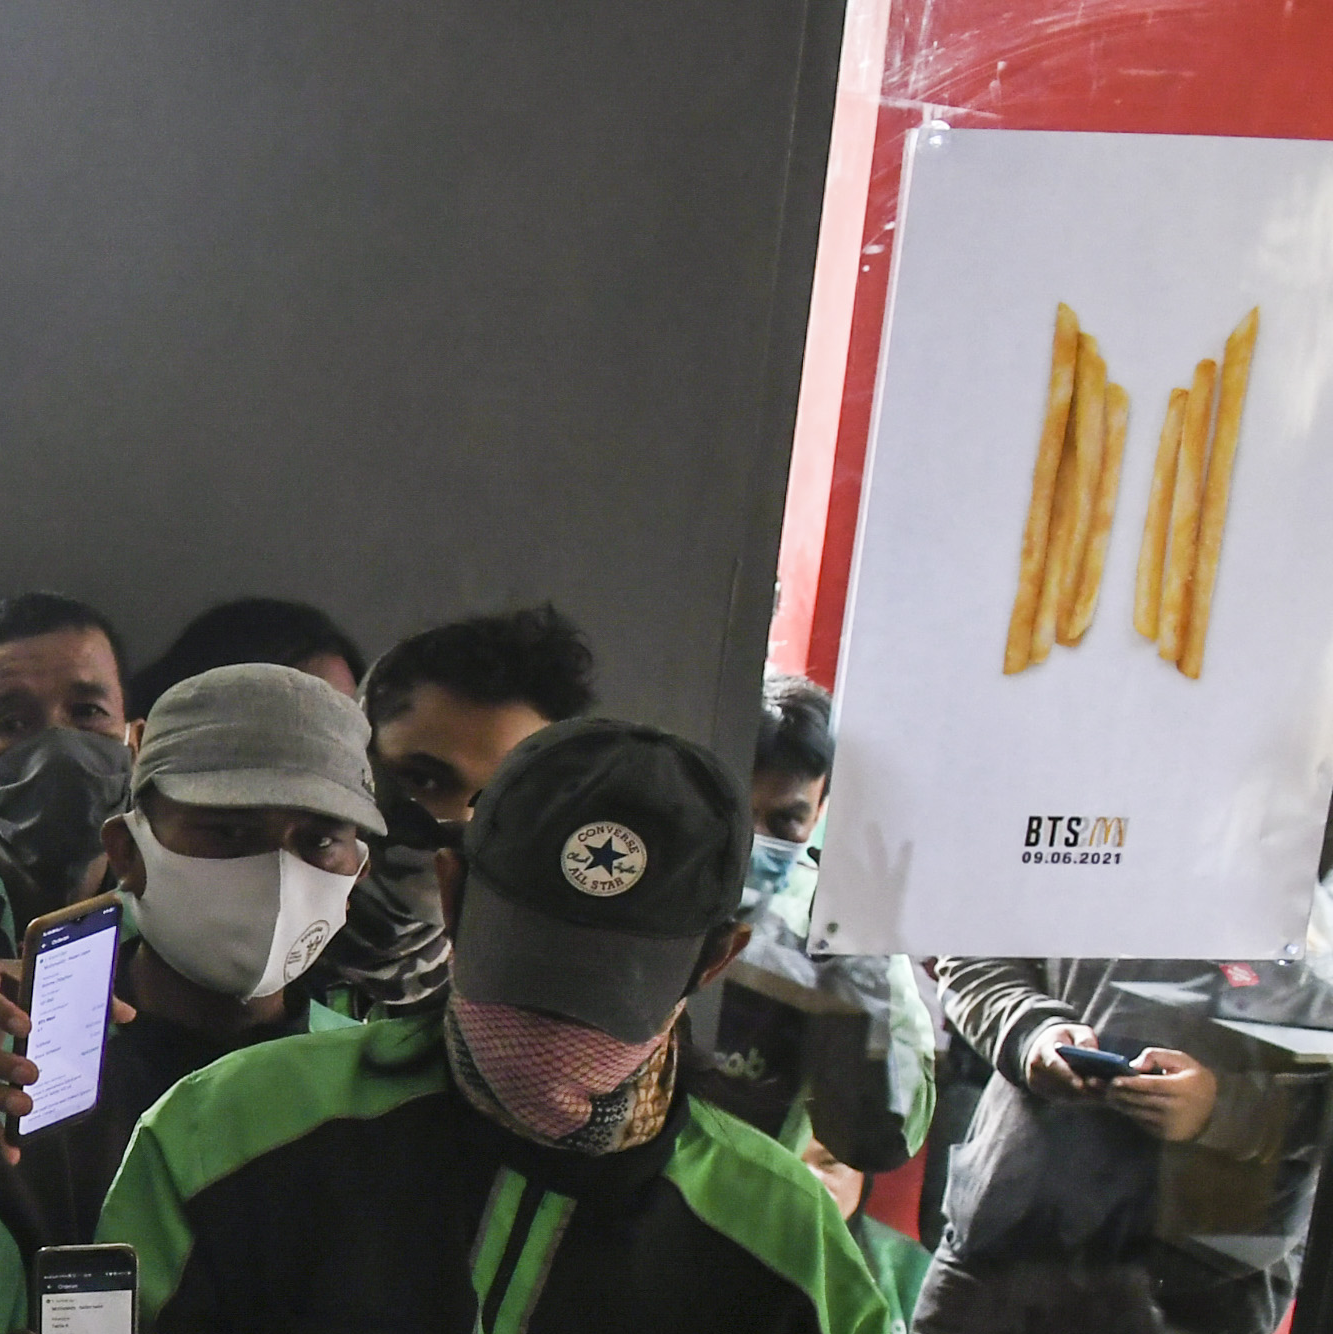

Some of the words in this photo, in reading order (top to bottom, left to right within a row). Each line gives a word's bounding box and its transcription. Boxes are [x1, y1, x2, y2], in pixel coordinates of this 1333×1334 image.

[578, 825, 640, 855] CONVERSE
[1024, 815, 1083, 847] BTS
[1021, 851, 1122, 865] 09.06.2021
[568, 866, 588, 886] ALL
[590, 876, 625, 891] STAR
